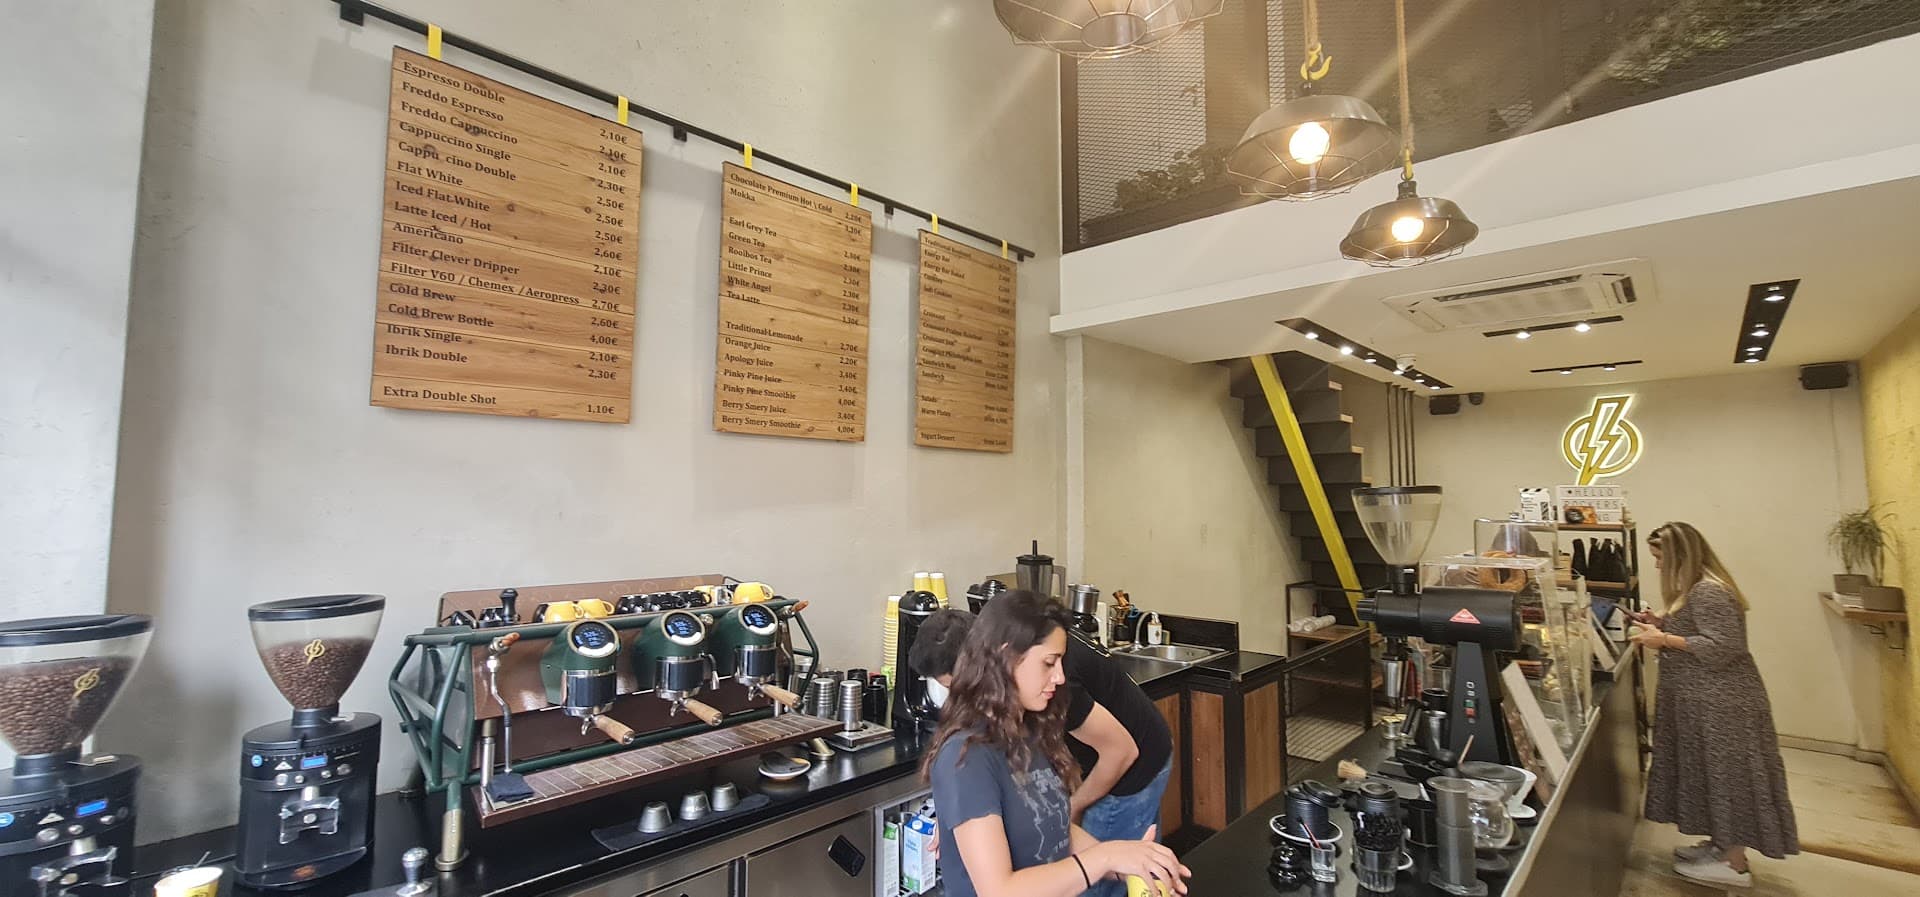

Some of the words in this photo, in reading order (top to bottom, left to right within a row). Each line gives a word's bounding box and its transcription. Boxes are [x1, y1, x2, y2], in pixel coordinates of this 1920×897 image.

[403, 61, 460, 88] Espresso
[464, 82, 505, 104] Double
[600, 128, 628, 144] 2,10€
[402, 82, 448, 103] Freddo
[451, 98, 503, 121] Espresso
[599, 145, 627, 161] 2,10€
[401, 102, 447, 123] Freddo
[450, 116, 518, 144] Cappuccino
[598, 162, 626, 178] 2,10€
[400, 122, 472, 150] Cappuccino
[476, 143, 512, 161] Single
[597, 179, 625, 194] 2,30€
[397, 161, 422, 176] Flat
[427, 168, 463, 186] White
[596, 213, 623, 228] 2,50€
[475, 162, 516, 181] Double
[596, 196, 624, 210] 2,50€
[730, 188, 755, 201] Mokka
[731, 173, 766, 191] Chocolate
[768, 186, 799, 201] Premium
[800, 196, 812, 206] Hot
[396, 181, 423, 196] Iced
[595, 230, 623, 244] 2,50€
[729, 217, 744, 228] Earl
[746, 222, 763, 234] Grey
[764, 228, 777, 237] Tea
[394, 201, 428, 217] Latte
[431, 209, 457, 224] Iced
[470, 218, 491, 231] Hot
[594, 247, 622, 261] 2,60€
[729, 232, 751, 244] Green
[752, 239, 765, 247] Tea
[392, 222, 463, 244] Americano
[594, 265, 621, 278] 2,10€
[760, 255, 772, 264] Tea
[392, 241, 428, 258] Filter
[432, 250, 470, 266] Clever
[474, 258, 519, 275] Dripper
[593, 282, 620, 295] 2,30€
[728, 261, 748, 272] Little
[750, 268, 772, 278] Prince
[728, 275, 749, 287] White
[752, 282, 772, 293] Angel
[391, 262, 427, 277] Filter
[431, 269, 455, 282] V60
[468, 277, 514, 294] Chemex
[592, 299, 619, 312] 2,70€
[727, 291, 740, 299] Tea
[742, 294, 760, 305] Latte
[390, 283, 418, 297] Cold
[423, 290, 456, 302] Brew
[591, 317, 619, 329] 2,60€
[388, 304, 418, 317] Cold
[421, 308, 454, 322] Brew
[458, 314, 494, 328] Bottle
[590, 335, 618, 346] 4,00€
[726, 321, 767, 335] Traditional
[768, 330, 803, 342] Lemonade
[840, 343, 858, 352] 2,70€
[387, 324, 420, 338] Ibrik
[424, 329, 462, 343] Single
[589, 351, 617, 363] 2,10€
[725, 338, 752, 349] Orange
[753, 342, 771, 351] Juice
[386, 345, 420, 358] Ibrik
[423, 349, 468, 363] Double
[589, 369, 616, 380] 2,30€
[725, 353, 755, 365] Apology
[756, 358, 774, 367] Juice
[723, 384, 744, 395] Pinky
[764, 390, 796, 400] Smoothie
[724, 369, 745, 380] Pinky
[747, 372, 763, 381] Pine
[764, 375, 782, 384] Juice
[384, 386, 418, 399] Extra
[423, 390, 467, 402] Double
[470, 394, 496, 405] Shot
[587, 404, 615, 415] 1,10€
[722, 400, 743, 410] Berry
[770, 405, 786, 414] Juice
[722, 415, 743, 425] Berry
[769, 420, 801, 429] Smoothie
[1575, 488, 1613, 496] HELLO
